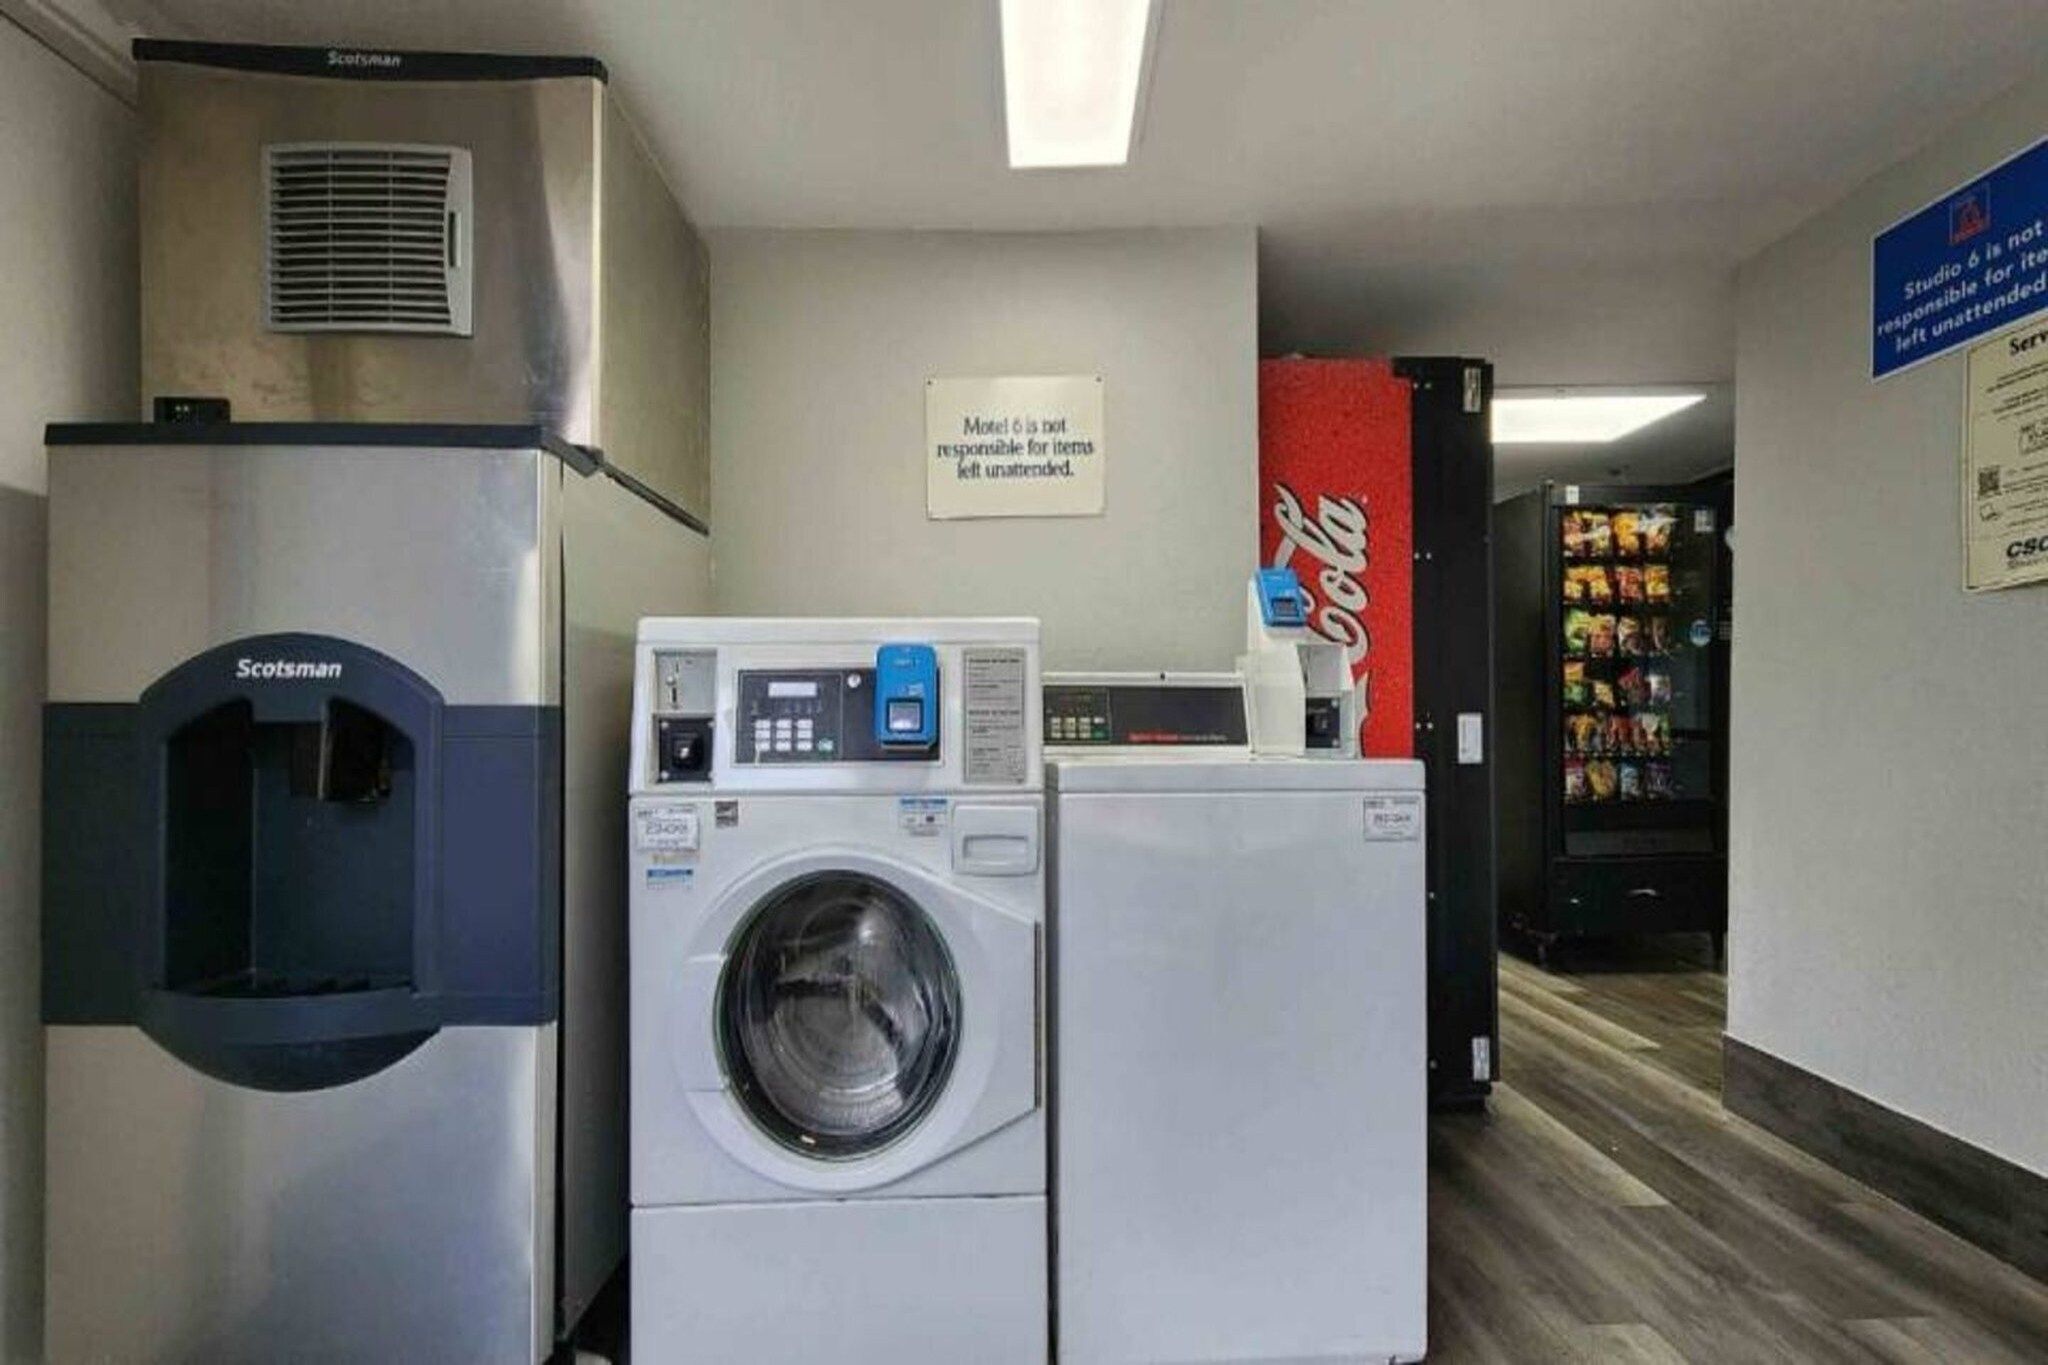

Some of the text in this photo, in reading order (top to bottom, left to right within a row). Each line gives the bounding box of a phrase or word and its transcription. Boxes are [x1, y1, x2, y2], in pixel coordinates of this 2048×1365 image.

[327, 50, 402, 67] Scotsman
[1903, 220, 2043, 300] Studio 6 is not
[1877, 280, 1978, 337] responsible
[1985, 263, 2015, 288] for
[1895, 271, 2048, 353] left unattended
[963, 416, 1067, 436] Motel 6 is not
[937, 438, 1095, 462] responsible for items
[957, 459, 1075, 479] left unattended.
[1272, 481, 1371, 667] Cola
[236, 659, 342, 678] Scotsman
